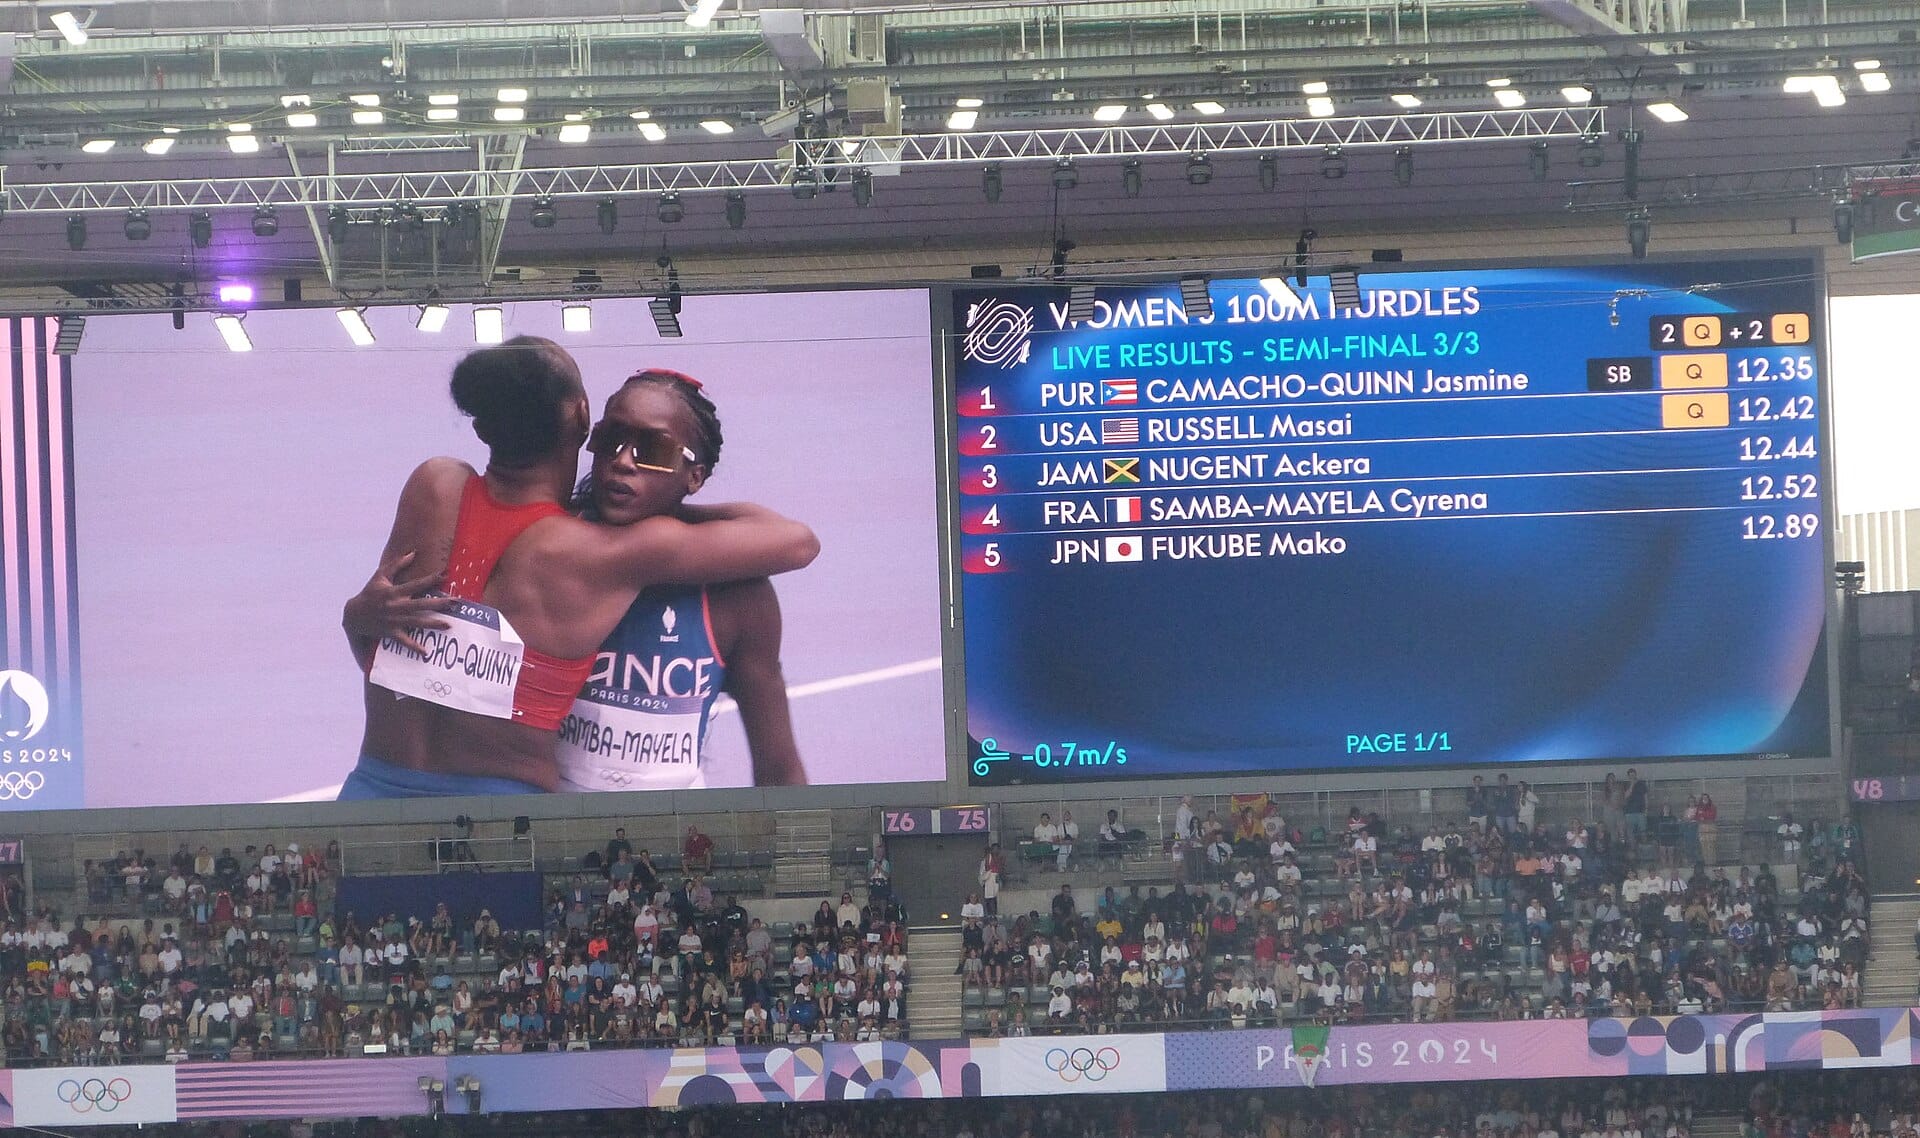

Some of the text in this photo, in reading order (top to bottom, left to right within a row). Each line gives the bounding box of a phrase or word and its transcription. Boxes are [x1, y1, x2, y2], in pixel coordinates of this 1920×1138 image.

[1662, 324, 1675, 343] 2
[1694, 323, 1710, 340] Q
[1750, 320, 1764, 340] 2
[1052, 344, 1111, 371] LIVE
[1119, 340, 1234, 368] RESULTS
[1263, 333, 1427, 362] SEMI-FINAL
[1433, 330, 1480, 356] 3/3
[979, 355, 1814, 411] 1 PUR CAMACHO-QUINN Jasmine SB Q 12.35
[980, 395, 1815, 449] 2 USA RUSSELL Masai Q 12.42
[982, 435, 1818, 489] 3 JAM NUGENT Ackera 12.44
[981, 473, 1818, 527] 4 FRA SAMBA-MAYELA Cyrena 12.52
[984, 513, 1819, 567] 5 JPN FUKUBE Mako 12.89
[459, 604, 491, 622] 2024
[632, 695, 669, 711] 2024
[1346, 731, 1452, 754] PAGE 1/1
[19, 748, 71, 764] 2024
[886, 812, 915, 832] Z6
[958, 810, 986, 830] Z5
